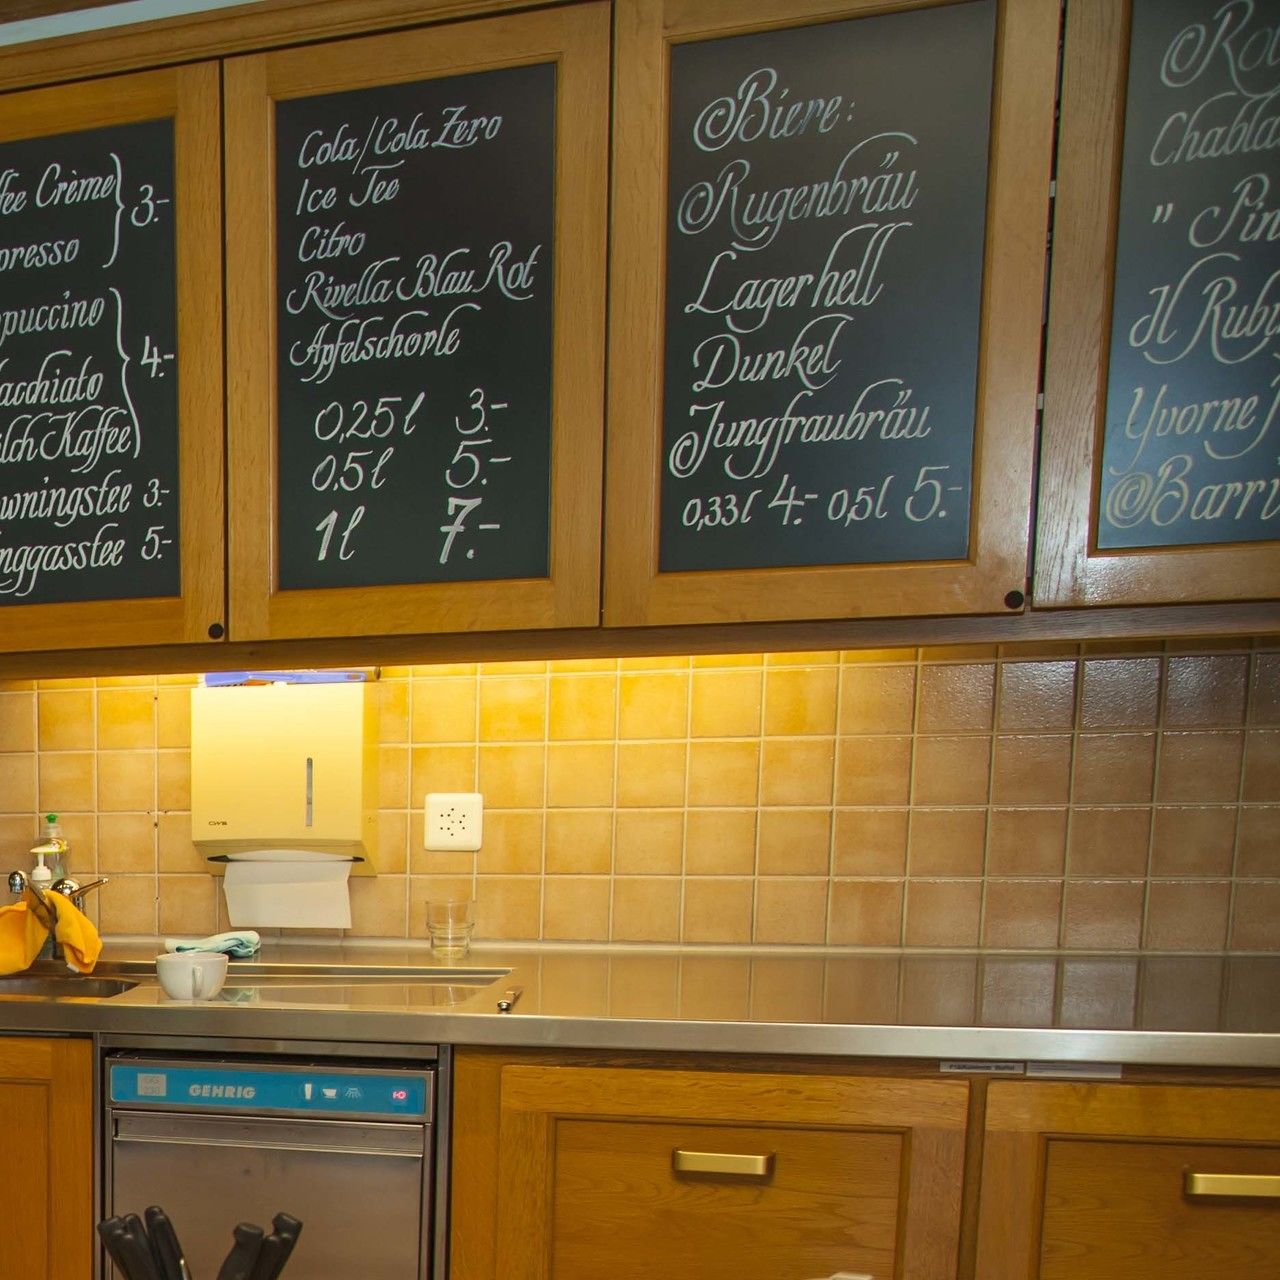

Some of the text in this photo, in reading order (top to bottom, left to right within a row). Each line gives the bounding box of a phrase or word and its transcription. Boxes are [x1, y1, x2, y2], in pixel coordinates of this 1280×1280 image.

[429, 105, 501, 149] Zero
[33, 163, 116, 208] Crème
[296, 160, 404, 216] Ice Tee
[676, 131, 919, 251] Rugenbräu
[285, 240, 539, 320] Rivella Blau Rot
[297, 224, 366, 263] Citro
[684, 250, 814, 334] Lager
[289, 303, 479, 384] Apfelschorle
[691, 313, 853, 392] Dunkel
[37, 405, 137, 474] Kaffee
[669, 378, 932, 479] Jungfraubräu
[1109, 384, 1259, 476] Yvorne
[188, 1084, 257, 1100] GEHRIG
